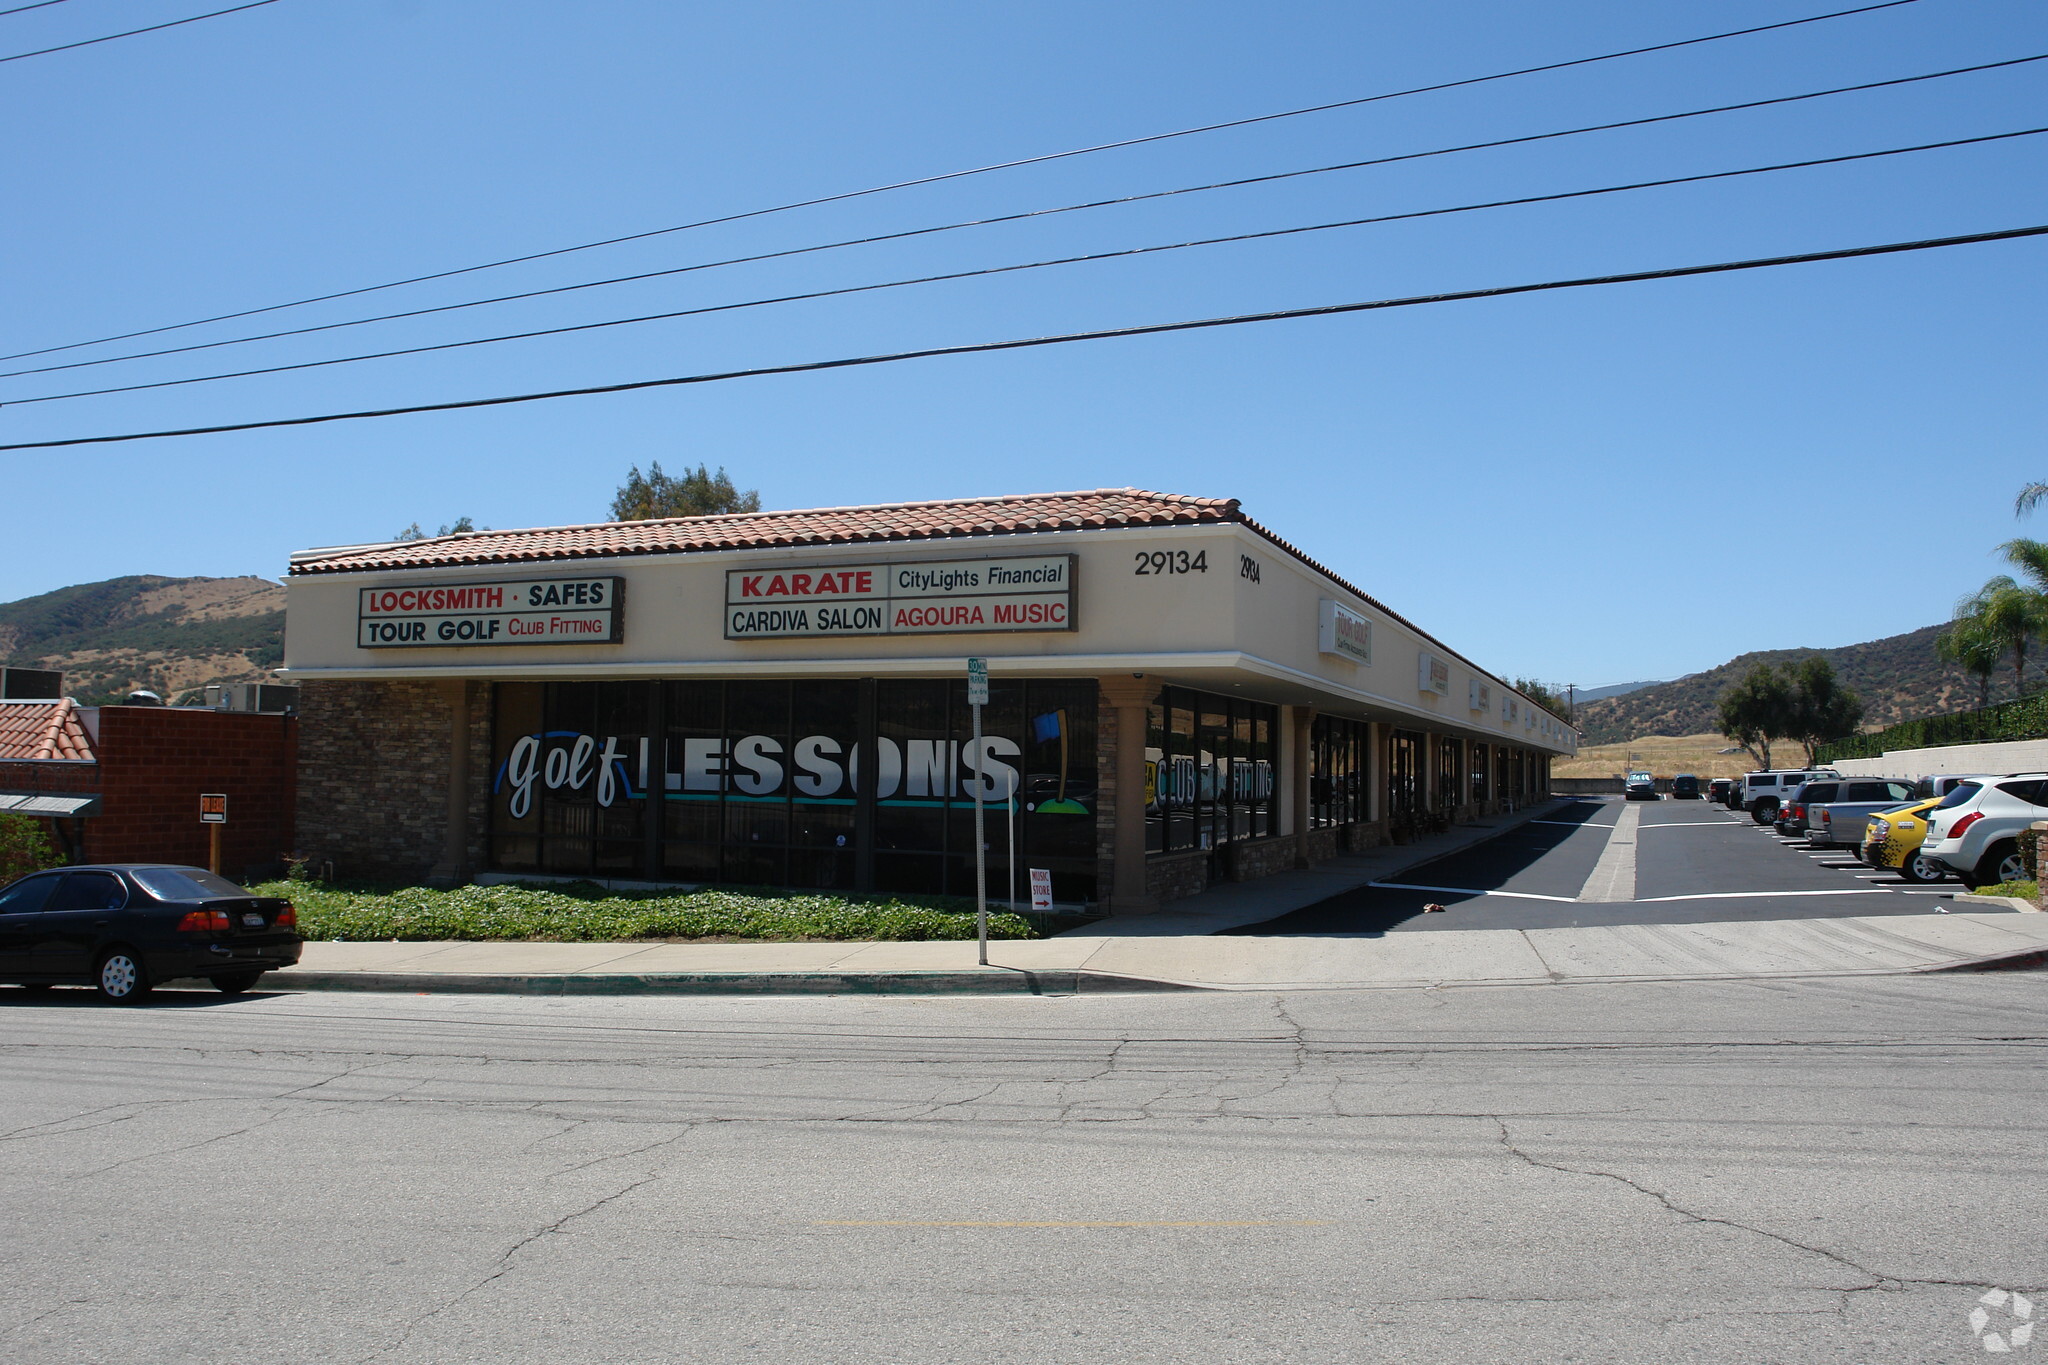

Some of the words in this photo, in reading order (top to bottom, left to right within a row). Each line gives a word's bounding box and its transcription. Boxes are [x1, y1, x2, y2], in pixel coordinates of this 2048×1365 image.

[1135, 550, 1208, 575] 29134
[1240, 554, 1260, 584] 29134
[742, 571, 872, 597] KARATE
[899, 568, 979, 591] CityLights
[988, 564, 1062, 585] Financial
[370, 587, 503, 612] LOCKSMITH
[528, 582, 604, 607] SAFES
[733, 608, 809, 632] CARDIVA
[817, 606, 882, 631] SALON
[895, 605, 985, 627] AGOURA
[993, 602, 1066, 624] MUSIC
[368, 622, 426, 642] TOUR
[437, 619, 500, 641] GOLF
[508, 734, 628, 818] golf
[1032, 871, 1049, 881] MUSIC
[1033, 885, 1050, 895] STORE
